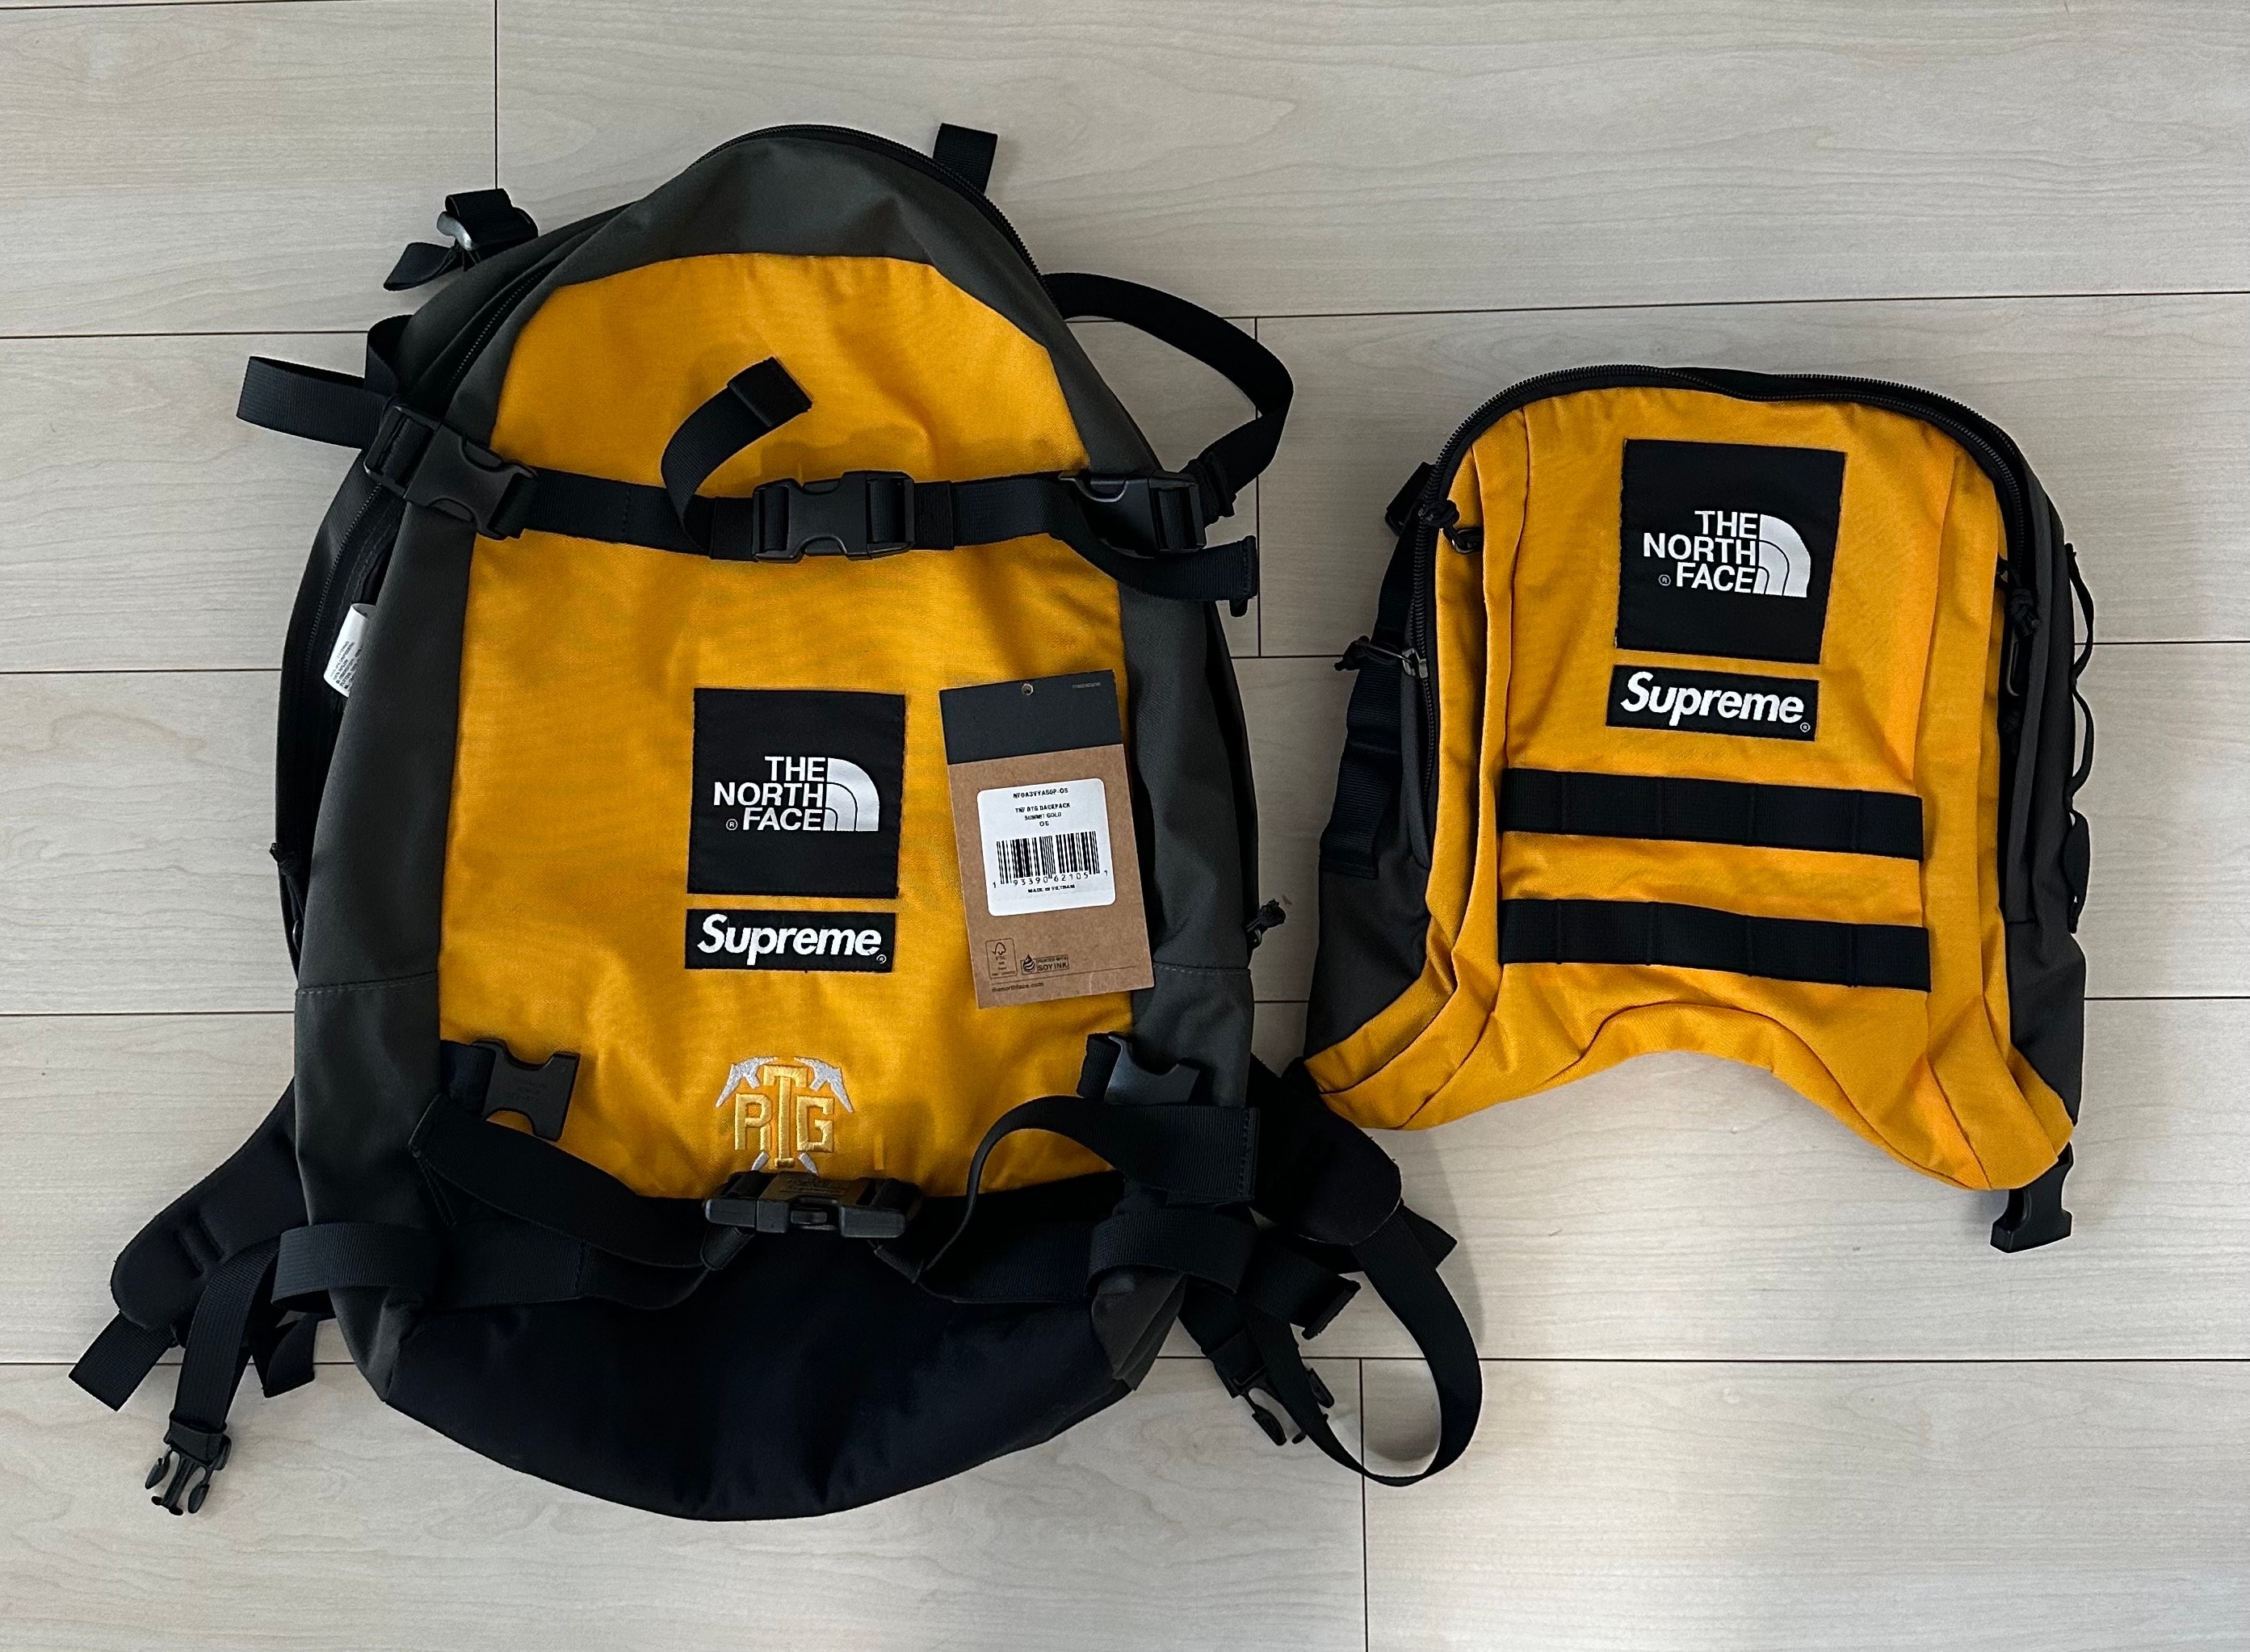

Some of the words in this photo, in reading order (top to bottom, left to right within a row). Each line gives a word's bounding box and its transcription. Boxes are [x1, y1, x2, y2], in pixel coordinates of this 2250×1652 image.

[1694, 510, 1758, 539] THE
[1643, 532, 1757, 565] NORTH
[1676, 562, 1756, 593] FACE
[1620, 671, 1804, 727] Supreme
[765, 756, 826, 782] THE
[713, 782, 824, 807] NORTH
[1039, 803, 1071, 811] BACKPACK
[742, 807, 821, 831] FACE
[697, 913, 882, 966] Supreme
[1036, 963, 1053, 971] SOY
